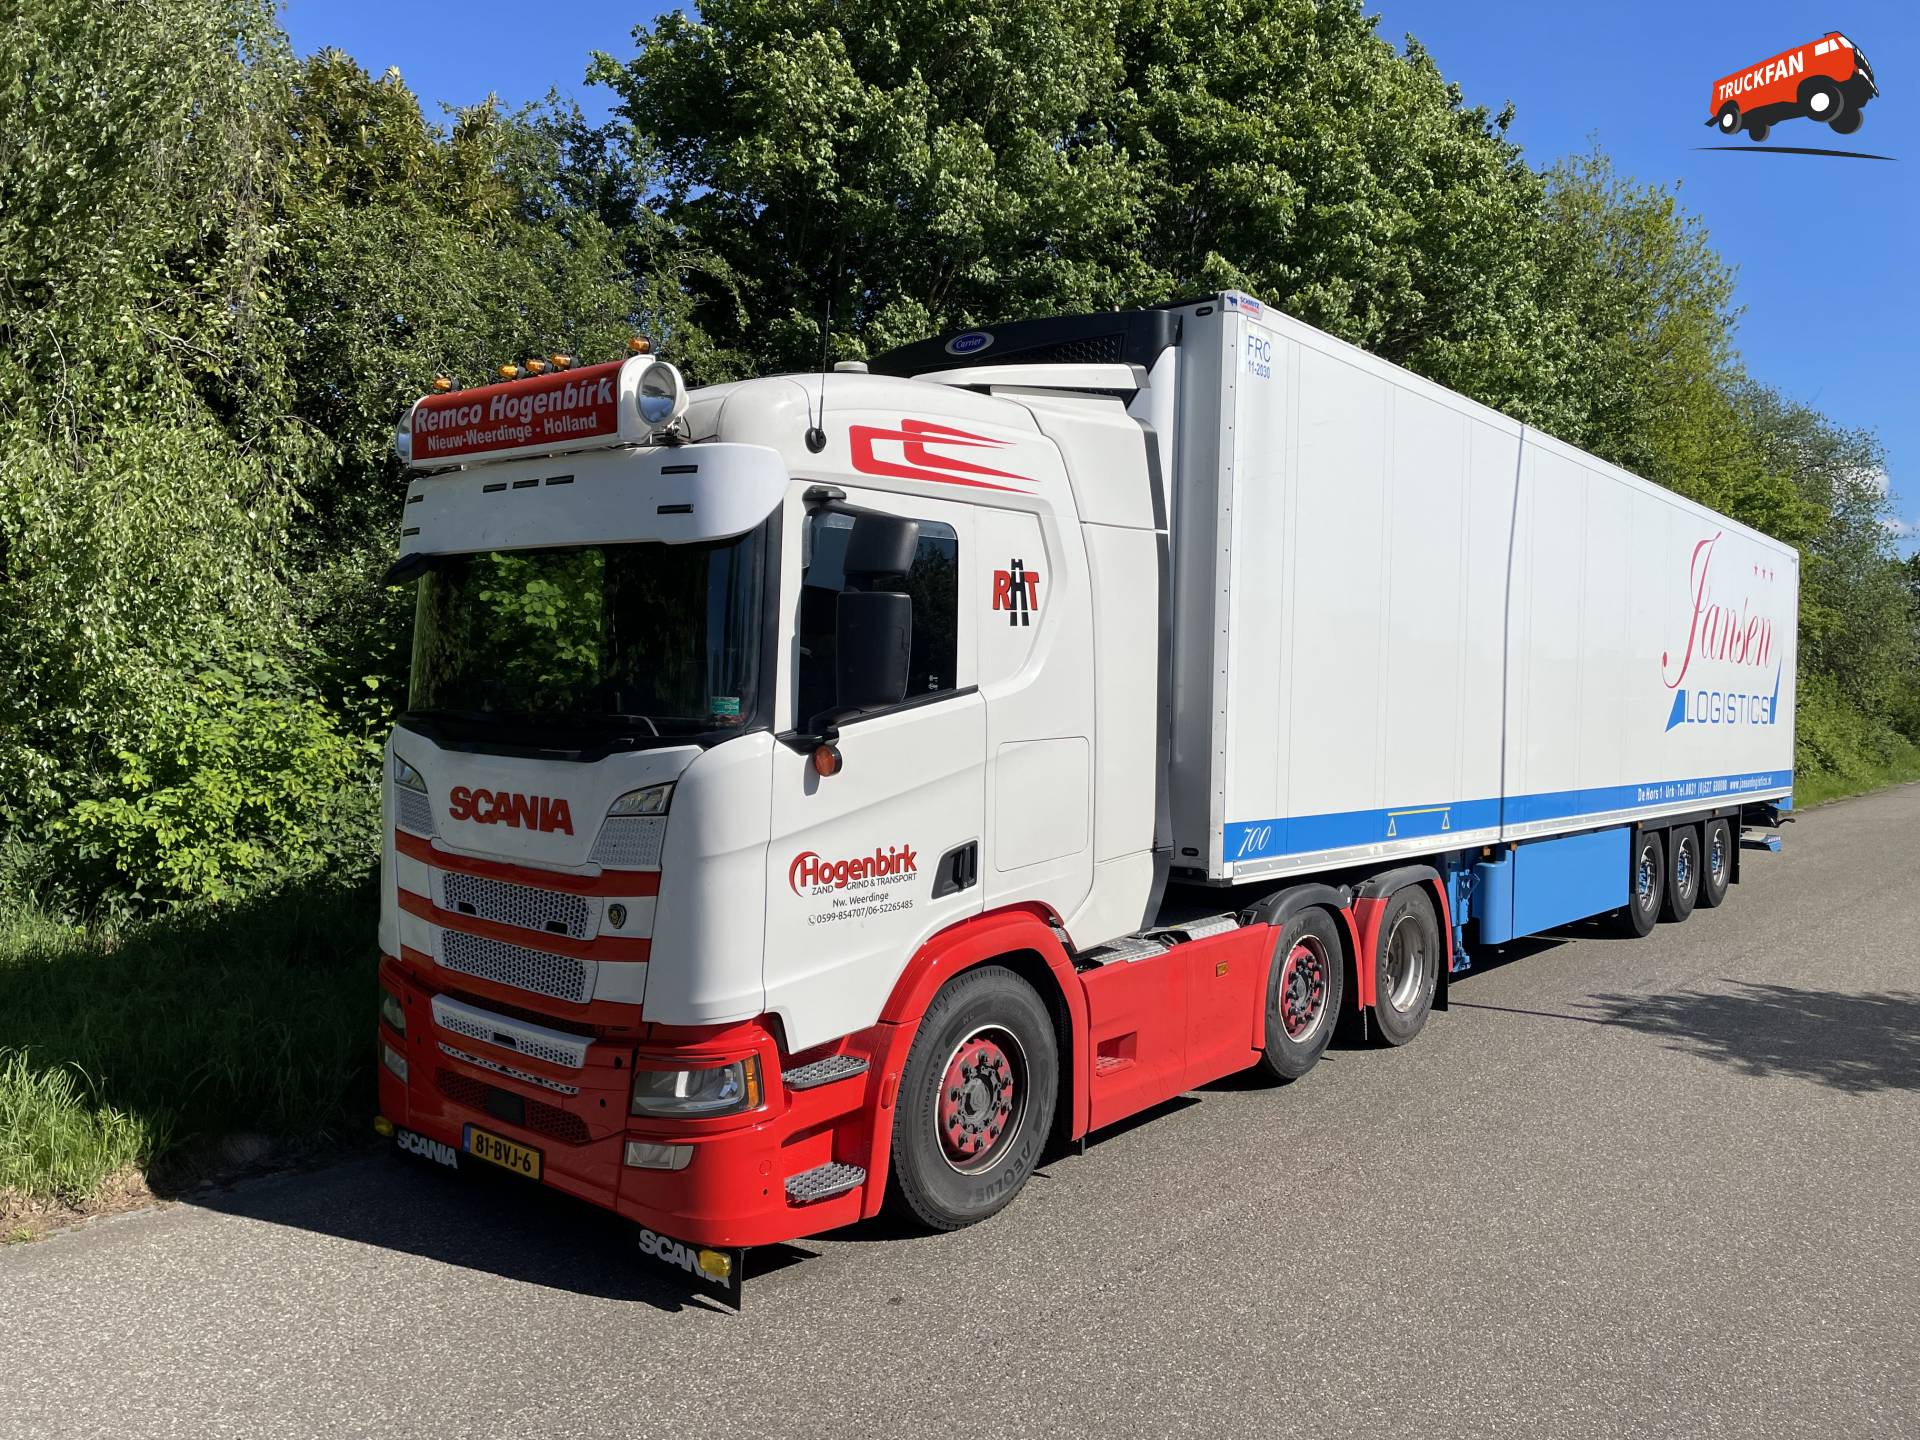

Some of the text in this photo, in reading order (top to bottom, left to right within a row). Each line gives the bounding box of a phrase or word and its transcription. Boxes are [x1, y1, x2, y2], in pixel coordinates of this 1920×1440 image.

[956, 338, 981, 349] Carrier
[1248, 335, 1271, 363] FRC
[1248, 360, 1271, 379] 11-2030
[415, 377, 614, 433] Remco Hogenbirk
[428, 424, 532, 451] Nieuw-Weerdinge
[544, 412, 597, 434] Holland
[1661, 531, 1772, 689] Jansen
[1687, 690, 1769, 724] LOGISTICS
[449, 786, 574, 836] SCANIA
[1237, 825, 1271, 857] 700
[800, 844, 917, 888] Hogenbirk
[812, 885, 834, 896] ZAND
[846, 880, 869, 891] GRIND
[876, 873, 917, 886] TRANSPORT
[832, 892, 889, 908] Nw. Weerdinge
[397, 1129, 459, 1170] SCANIA
[475, 1134, 532, 1173] 81-BVJ-6
[639, 1229, 731, 1289] SCAN
